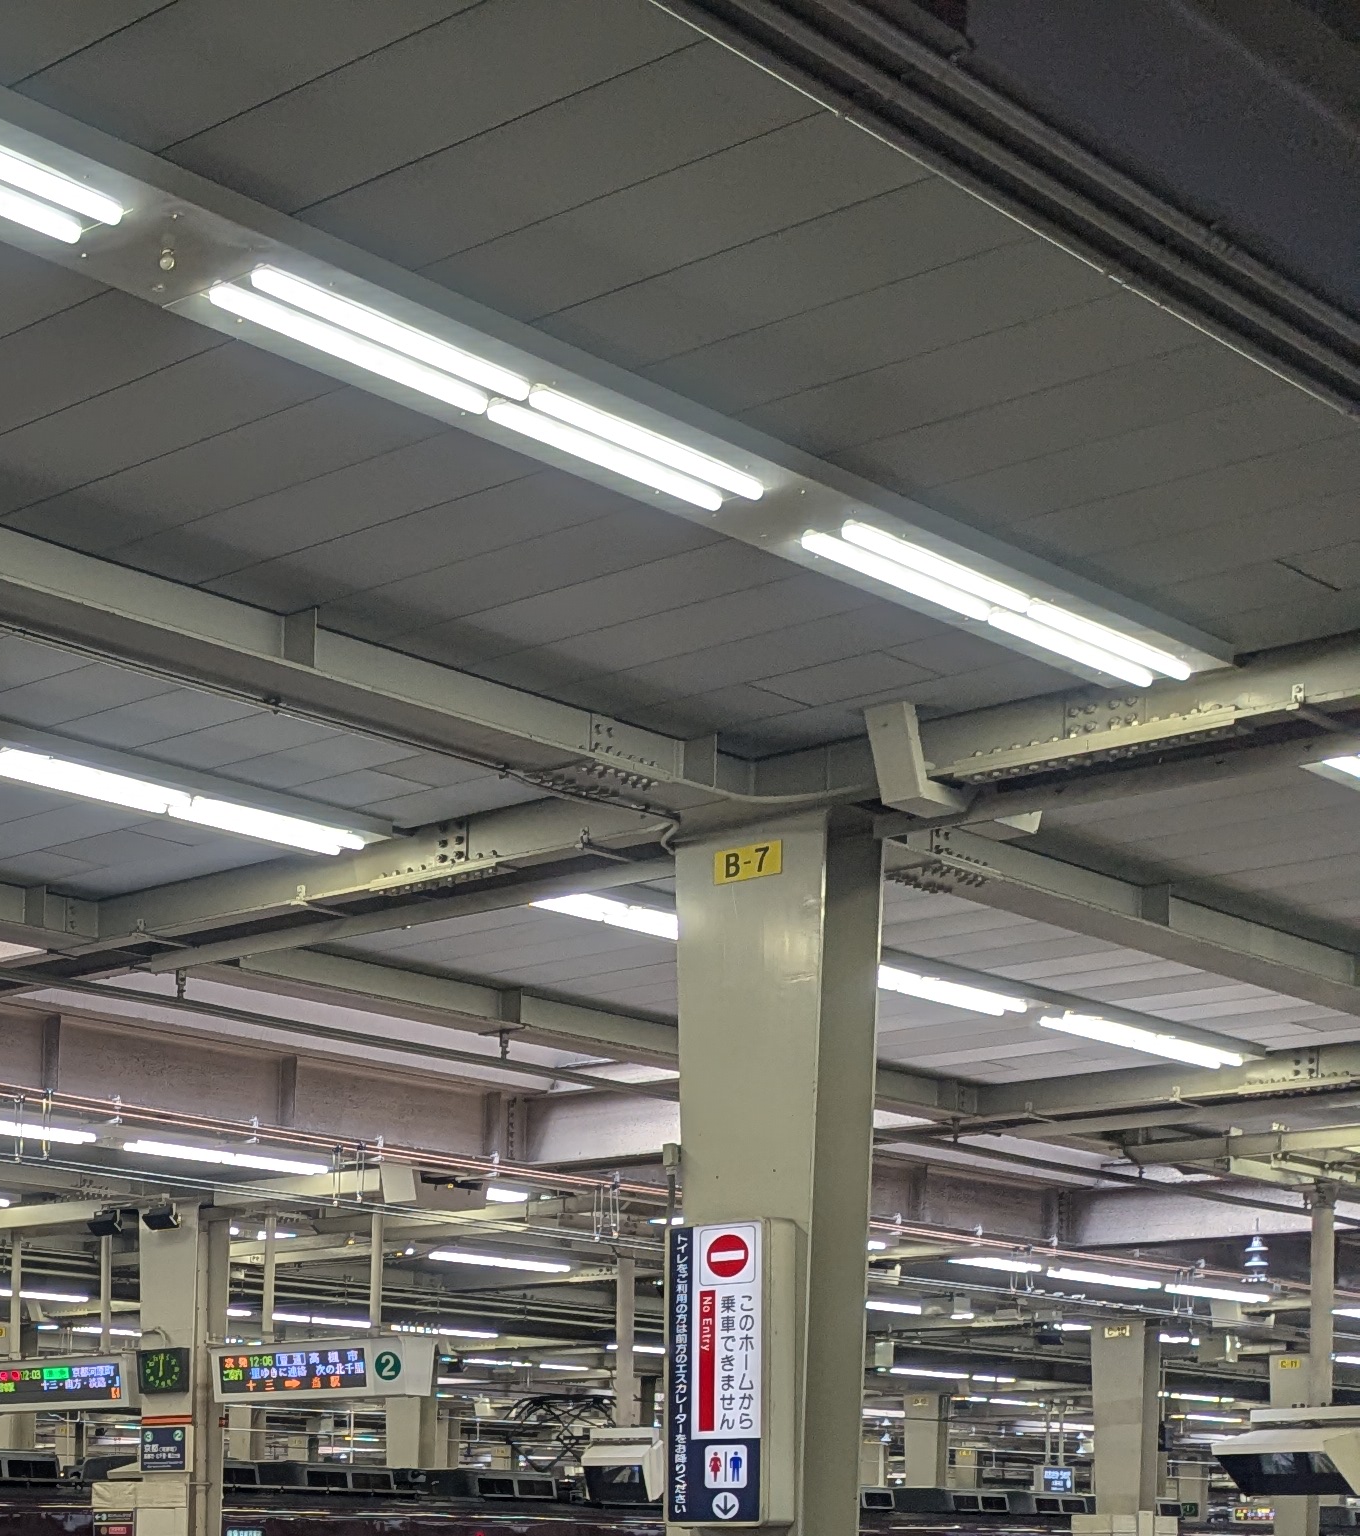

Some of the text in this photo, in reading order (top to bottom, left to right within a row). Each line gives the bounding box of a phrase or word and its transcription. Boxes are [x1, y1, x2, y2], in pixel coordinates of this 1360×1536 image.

[724, 845, 770, 879] B-7
[700, 1296, 713, 1352] No Entry
[315, 1361, 365, 1376] 次の北千里
[380, 1354, 397, 1377] 2
[674, 1233, 689, 1514] トイレをご利用の方は前方のエスカレーターをお降りください
[719, 1294, 736, 1431] 乗車できません
[739, 1294, 755, 1430] このホームから
[245, 1379, 276, 1392] 十三
